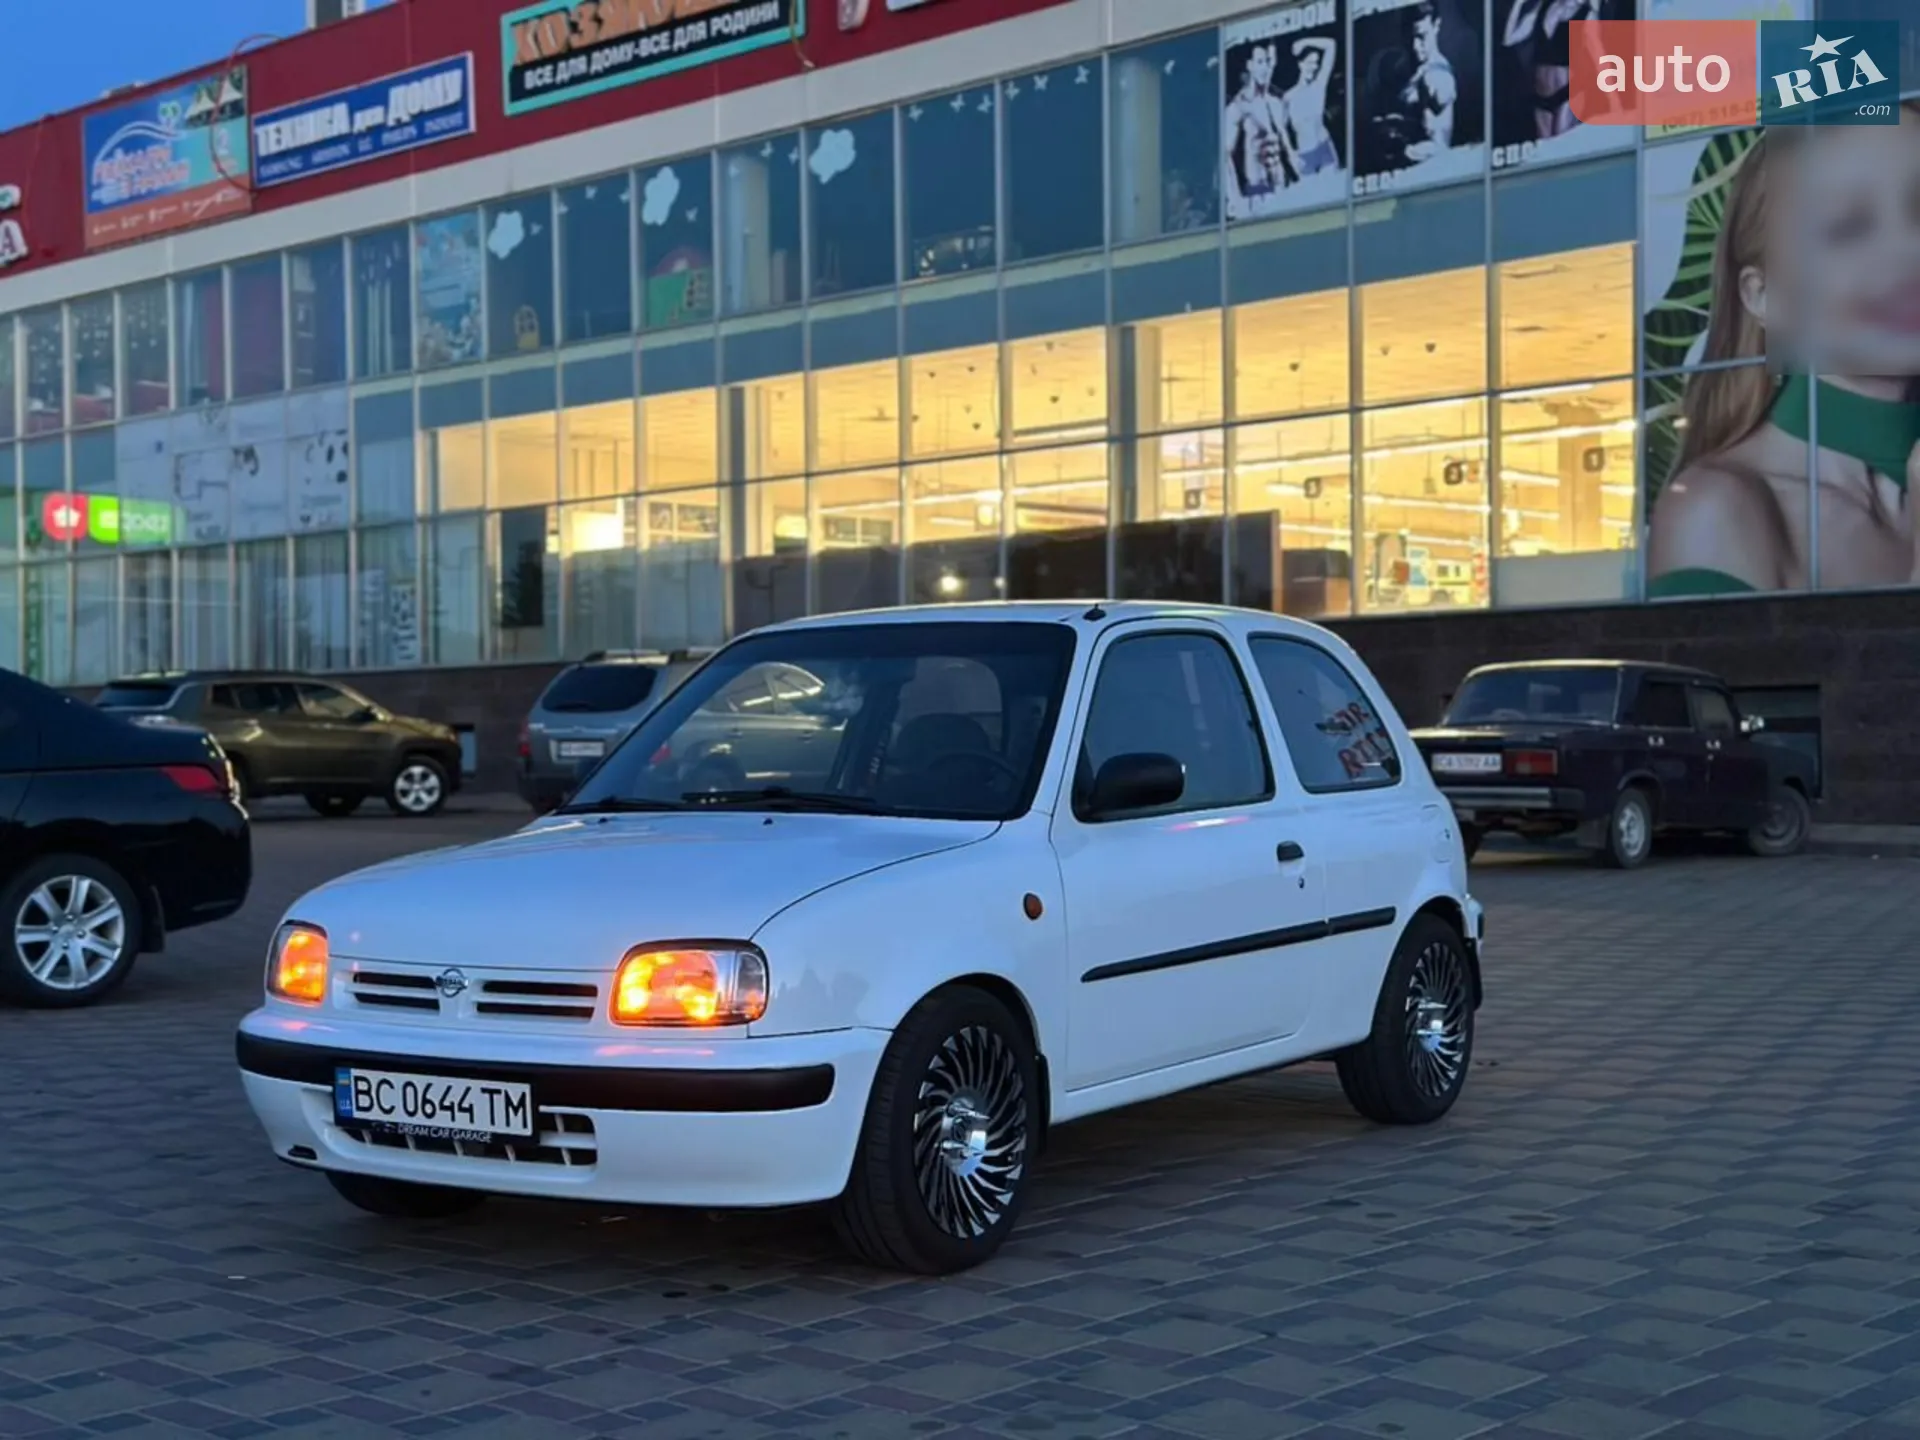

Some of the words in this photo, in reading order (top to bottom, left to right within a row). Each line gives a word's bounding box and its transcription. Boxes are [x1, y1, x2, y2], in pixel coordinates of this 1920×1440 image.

[524, 66, 555, 90] ВСЕ
[556, 56, 588, 84] ДЛЯ
[673, 20, 709, 51] ДЛЯ
[710, 0, 780, 37] РОДИНИ
[386, 68, 463, 127] ДОМУ
[353, 1075, 396, 1115] BC
[402, 1081, 475, 1124] 0644
[481, 1087, 528, 1129] TM
[397, 1123, 430, 1138] DREAM
[430, 1125, 450, 1139] CAR
[451, 1129, 493, 1143] GARAGE
